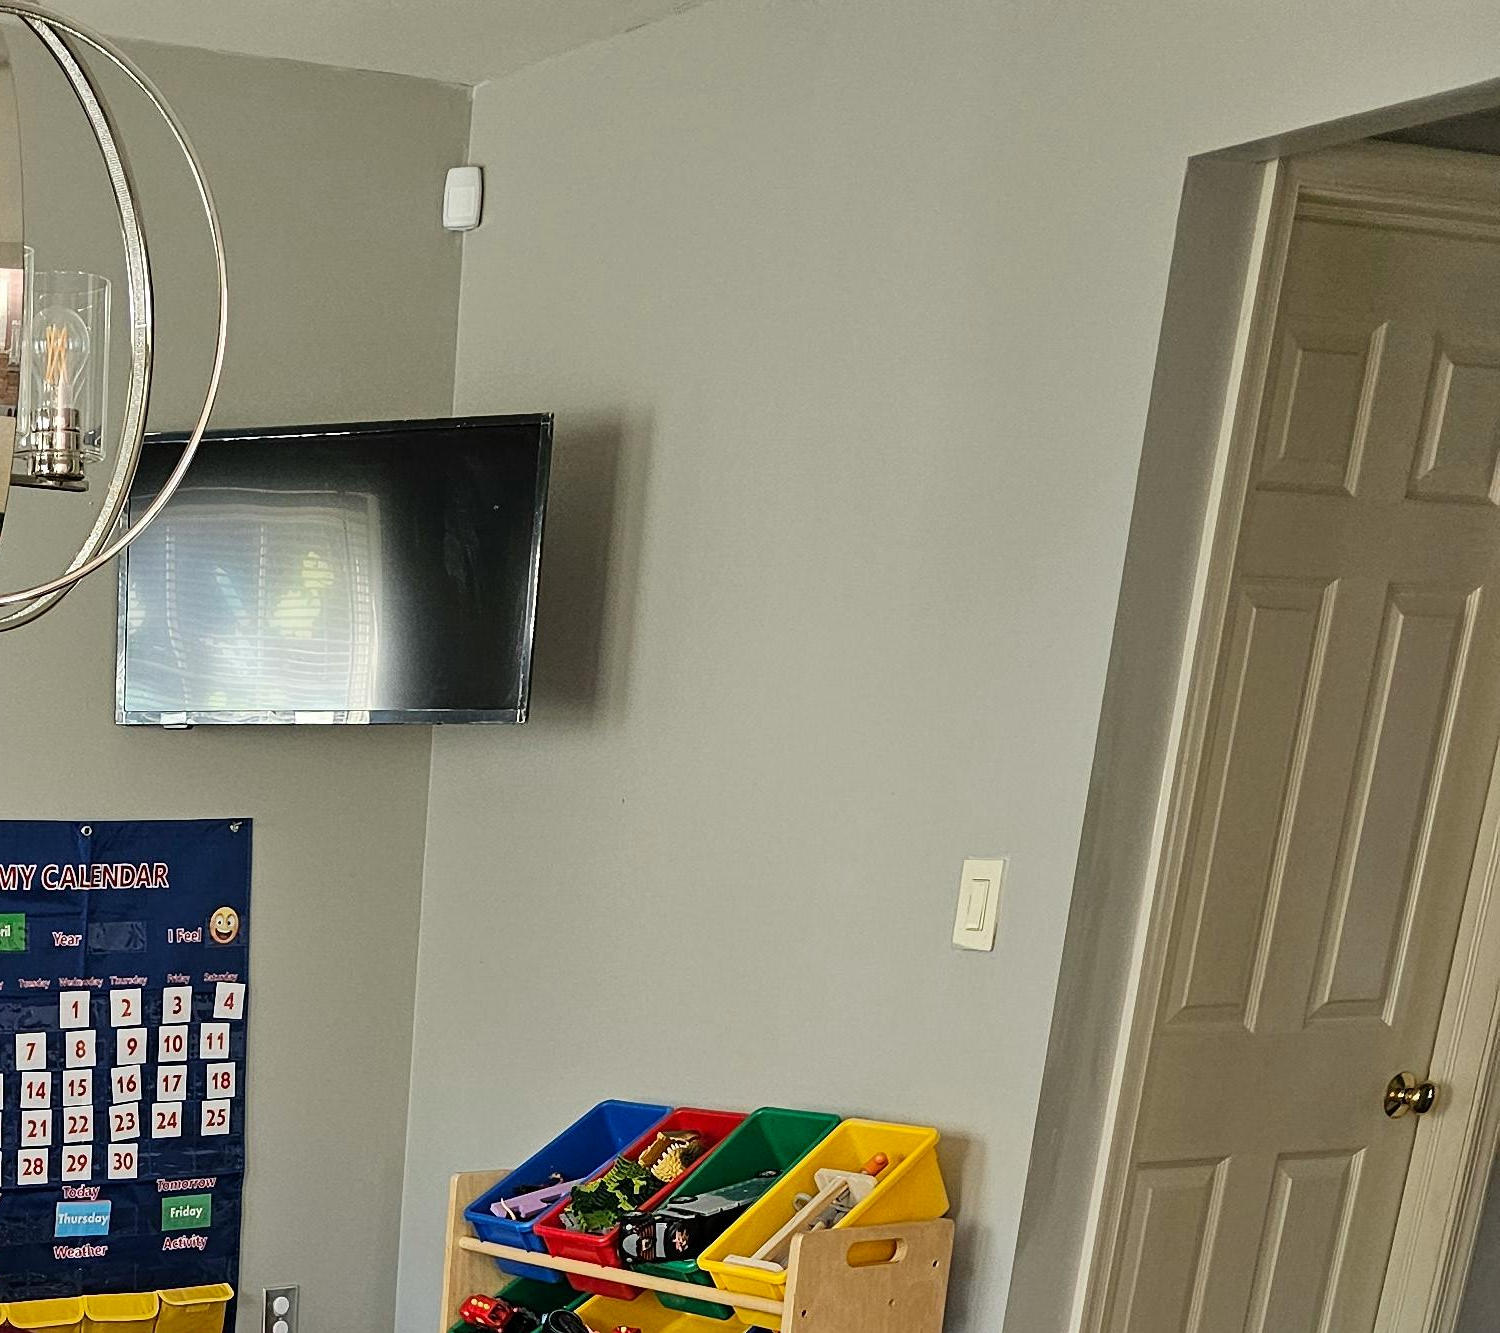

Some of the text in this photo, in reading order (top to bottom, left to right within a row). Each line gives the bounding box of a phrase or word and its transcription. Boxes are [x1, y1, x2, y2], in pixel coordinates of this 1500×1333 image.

[41, 863, 170, 890] CALENDAR
[52, 932, 83, 947] Year
[168, 927, 203, 944] I Feel
[18, 978, 51, 990] Tuesday
[59, 976, 104, 989] Wednesday
[109, 975, 148, 987] Thursday
[166, 974, 191, 985] Friday
[203, 972, 239, 983] Saturday
[72, 992, 234, 1019] 1 2 3 4
[26, 1042, 36, 1060] 7
[75, 1040, 86, 1058] 8
[127, 1038, 138, 1056] 9
[164, 1035, 183, 1052] 10
[207, 1032, 223, 1050] 11
[27, 1081, 46, 1099] 14
[68, 1079, 87, 1096] 15
[117, 1074, 136, 1093] 16
[163, 1075, 182, 1092] 17
[212, 1072, 231, 1089] 18
[28, 1120, 47, 1137] 21
[68, 1115, 89, 1134] 22
[115, 1113, 135, 1132] 23
[157, 1112, 177, 1129] 24
[206, 1109, 226, 1127] 25
[23, 1158, 44, 1176] 28
[67, 1154, 88, 1172] 29
[113, 1153, 133, 1170] 30
[62, 1185, 100, 1200] Today
[156, 1176, 217, 1192] Tomorrow
[58, 1213, 109, 1226] Thursday
[170, 1206, 203, 1218] Friday
[53, 1235, 208, 1260] Weather Activity
